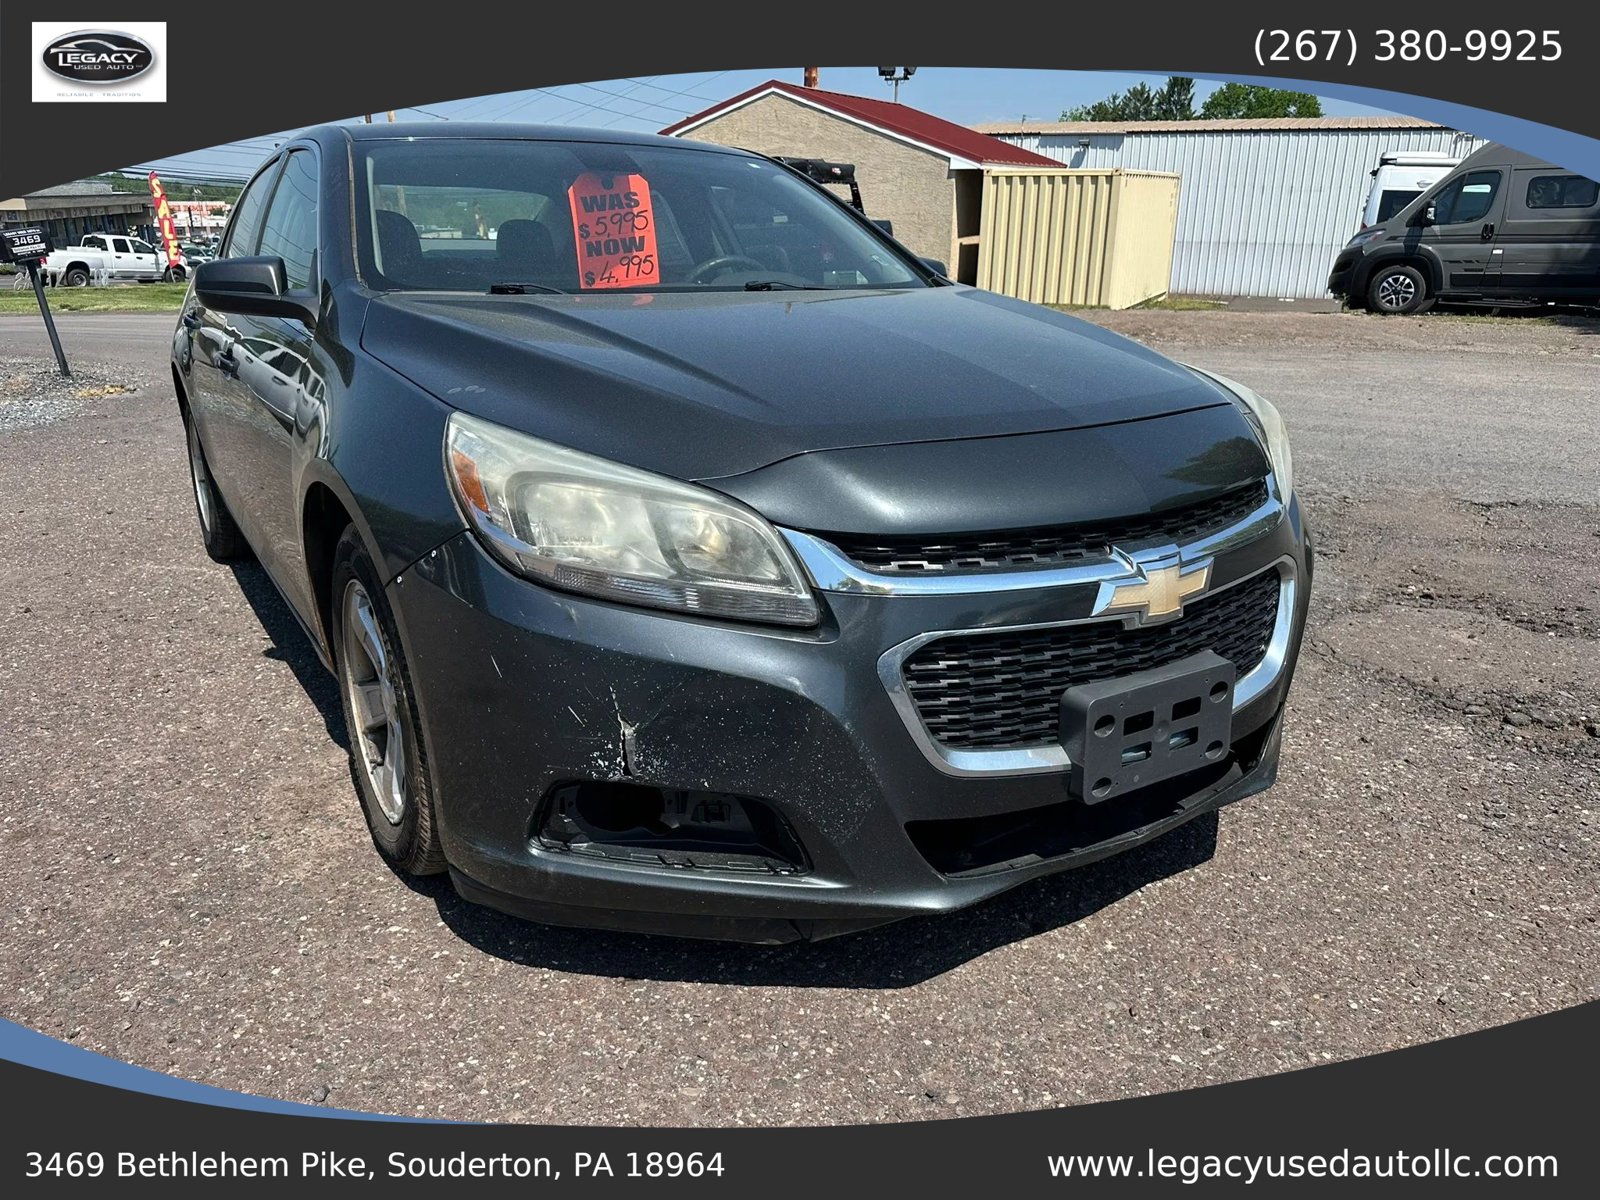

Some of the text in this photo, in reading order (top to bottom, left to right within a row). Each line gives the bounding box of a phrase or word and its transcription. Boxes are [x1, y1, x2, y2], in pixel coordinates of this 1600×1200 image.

[580, 191, 641, 214] WAS
[151, 178, 179, 261] SALE
[12, 234, 41, 246] 3469
[584, 235, 646, 258] NOW
